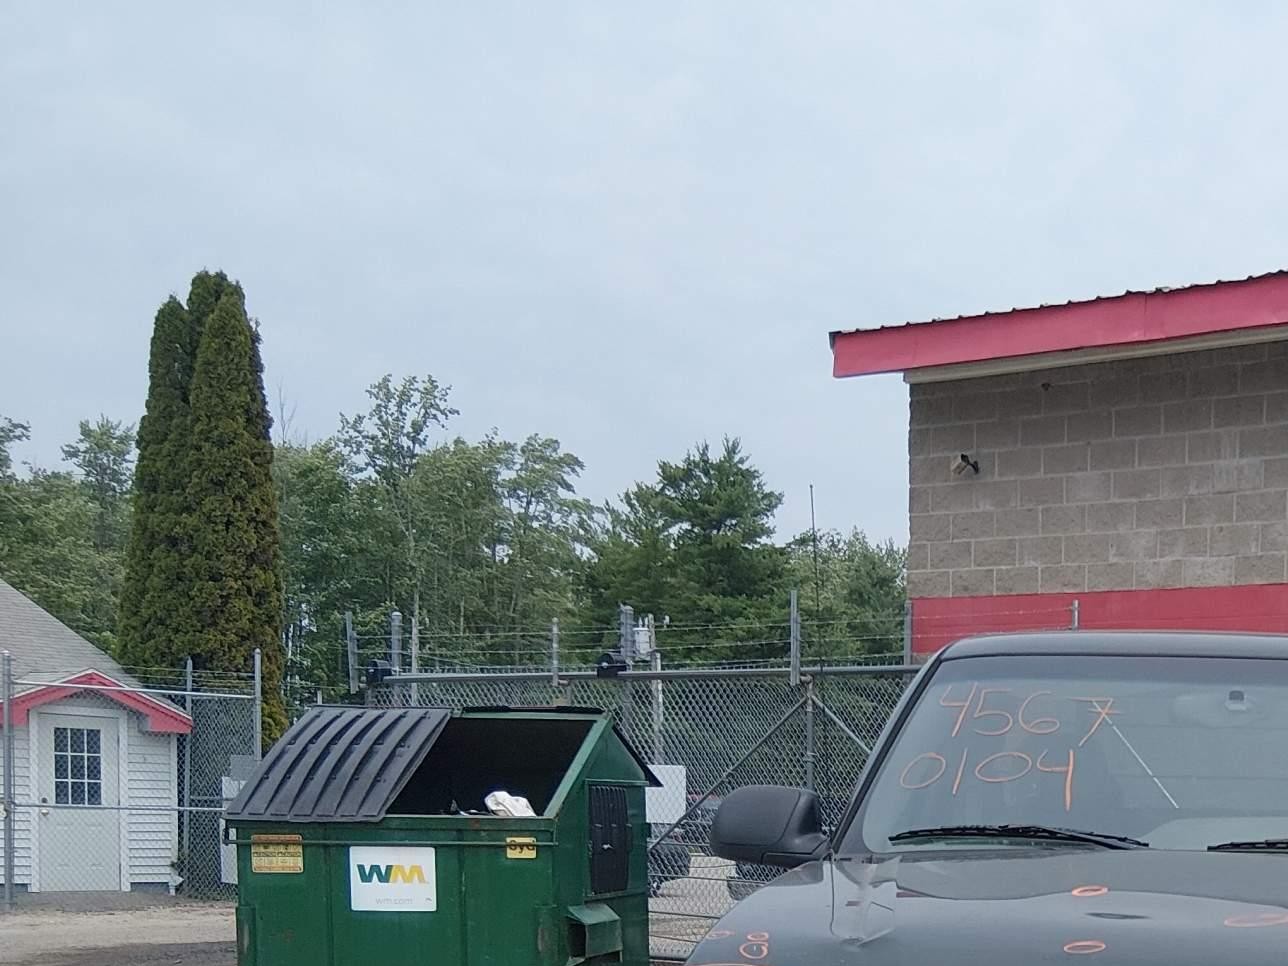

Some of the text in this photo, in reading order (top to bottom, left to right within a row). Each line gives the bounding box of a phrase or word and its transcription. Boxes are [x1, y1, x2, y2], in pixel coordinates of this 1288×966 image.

[939, 681, 1124, 747] 4567
[900, 748, 1076, 812] 0104
[356, 864, 427, 884] WM
